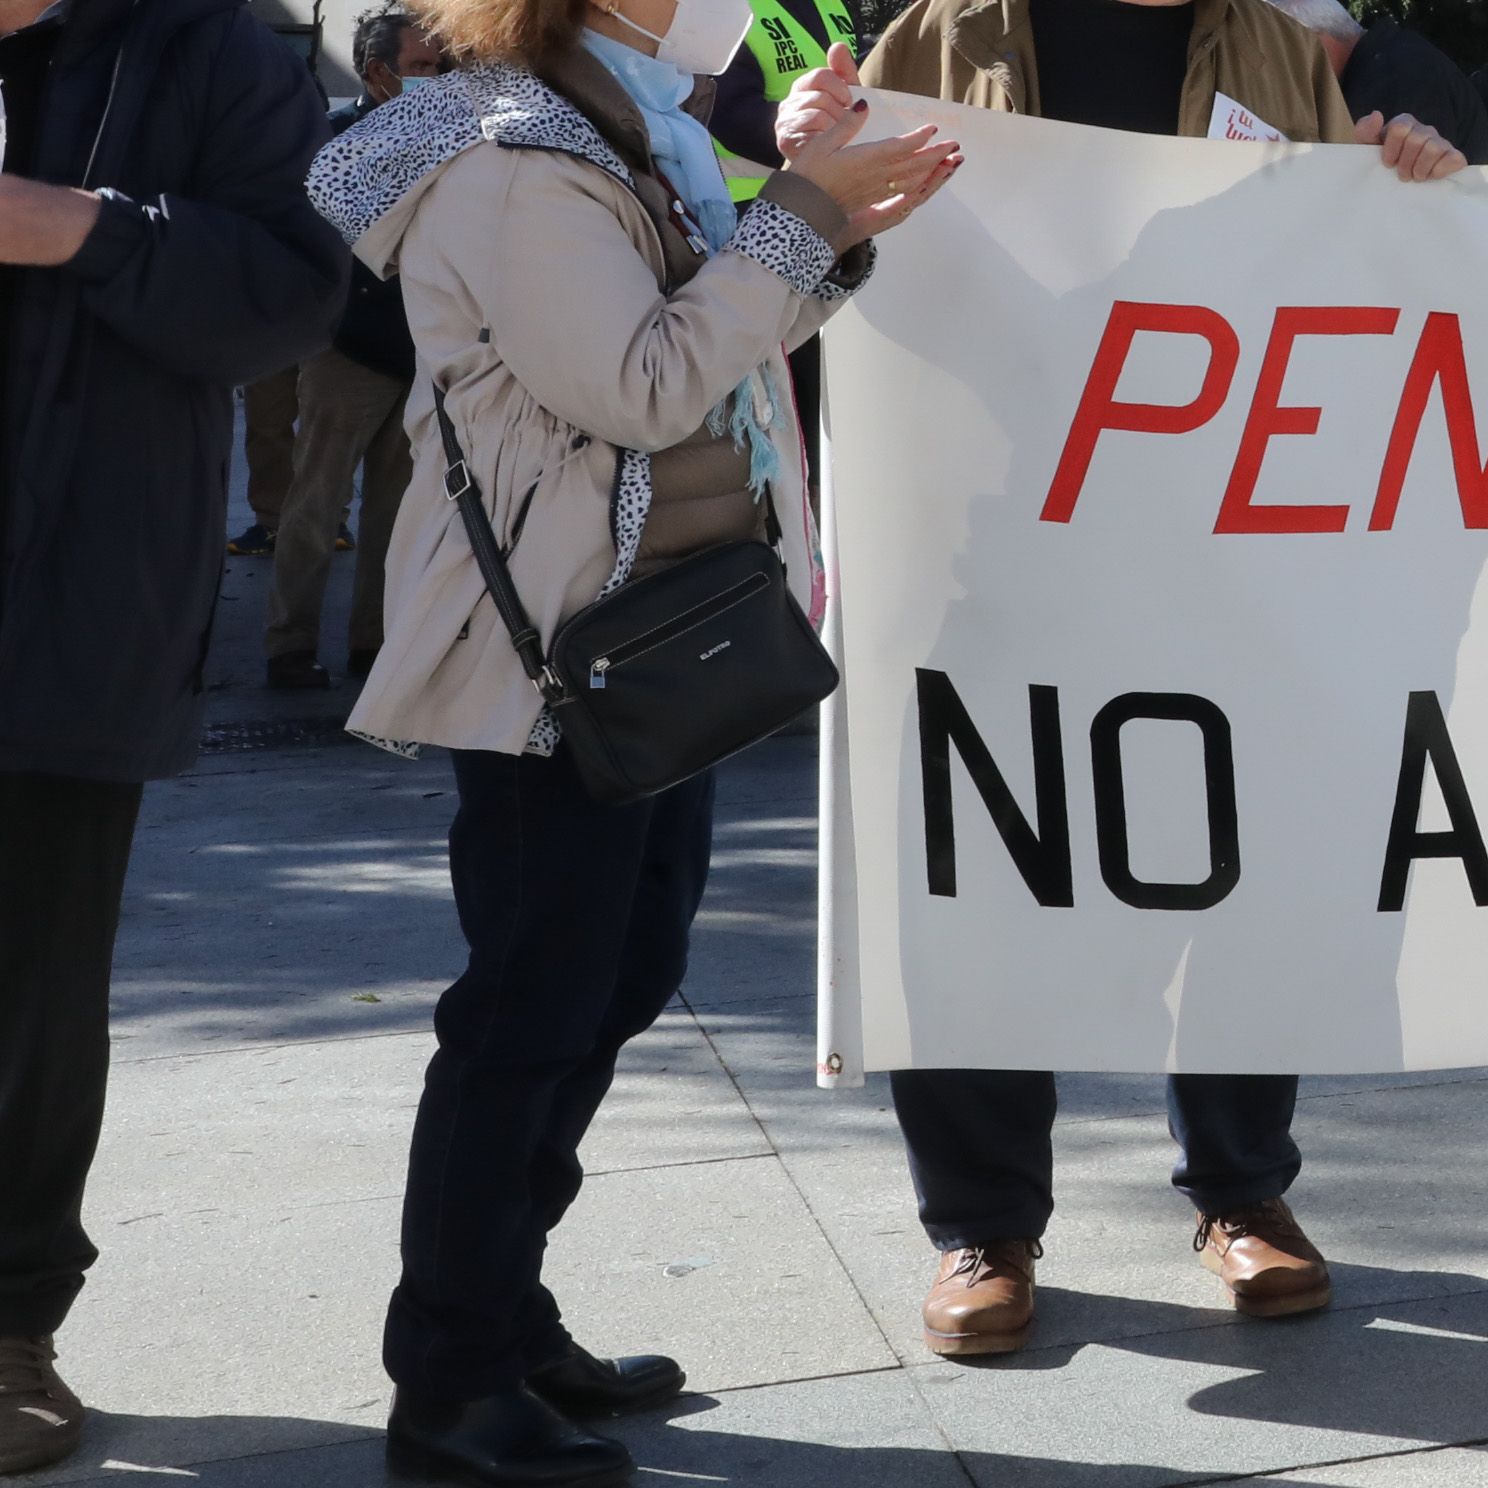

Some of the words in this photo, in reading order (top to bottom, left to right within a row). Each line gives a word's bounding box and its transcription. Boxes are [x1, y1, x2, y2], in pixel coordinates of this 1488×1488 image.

[760, 16, 792, 41] SI
[773, 39, 798, 57] IPC
[776, 54, 808, 74] REAL
[915, 666, 1242, 911] NO
